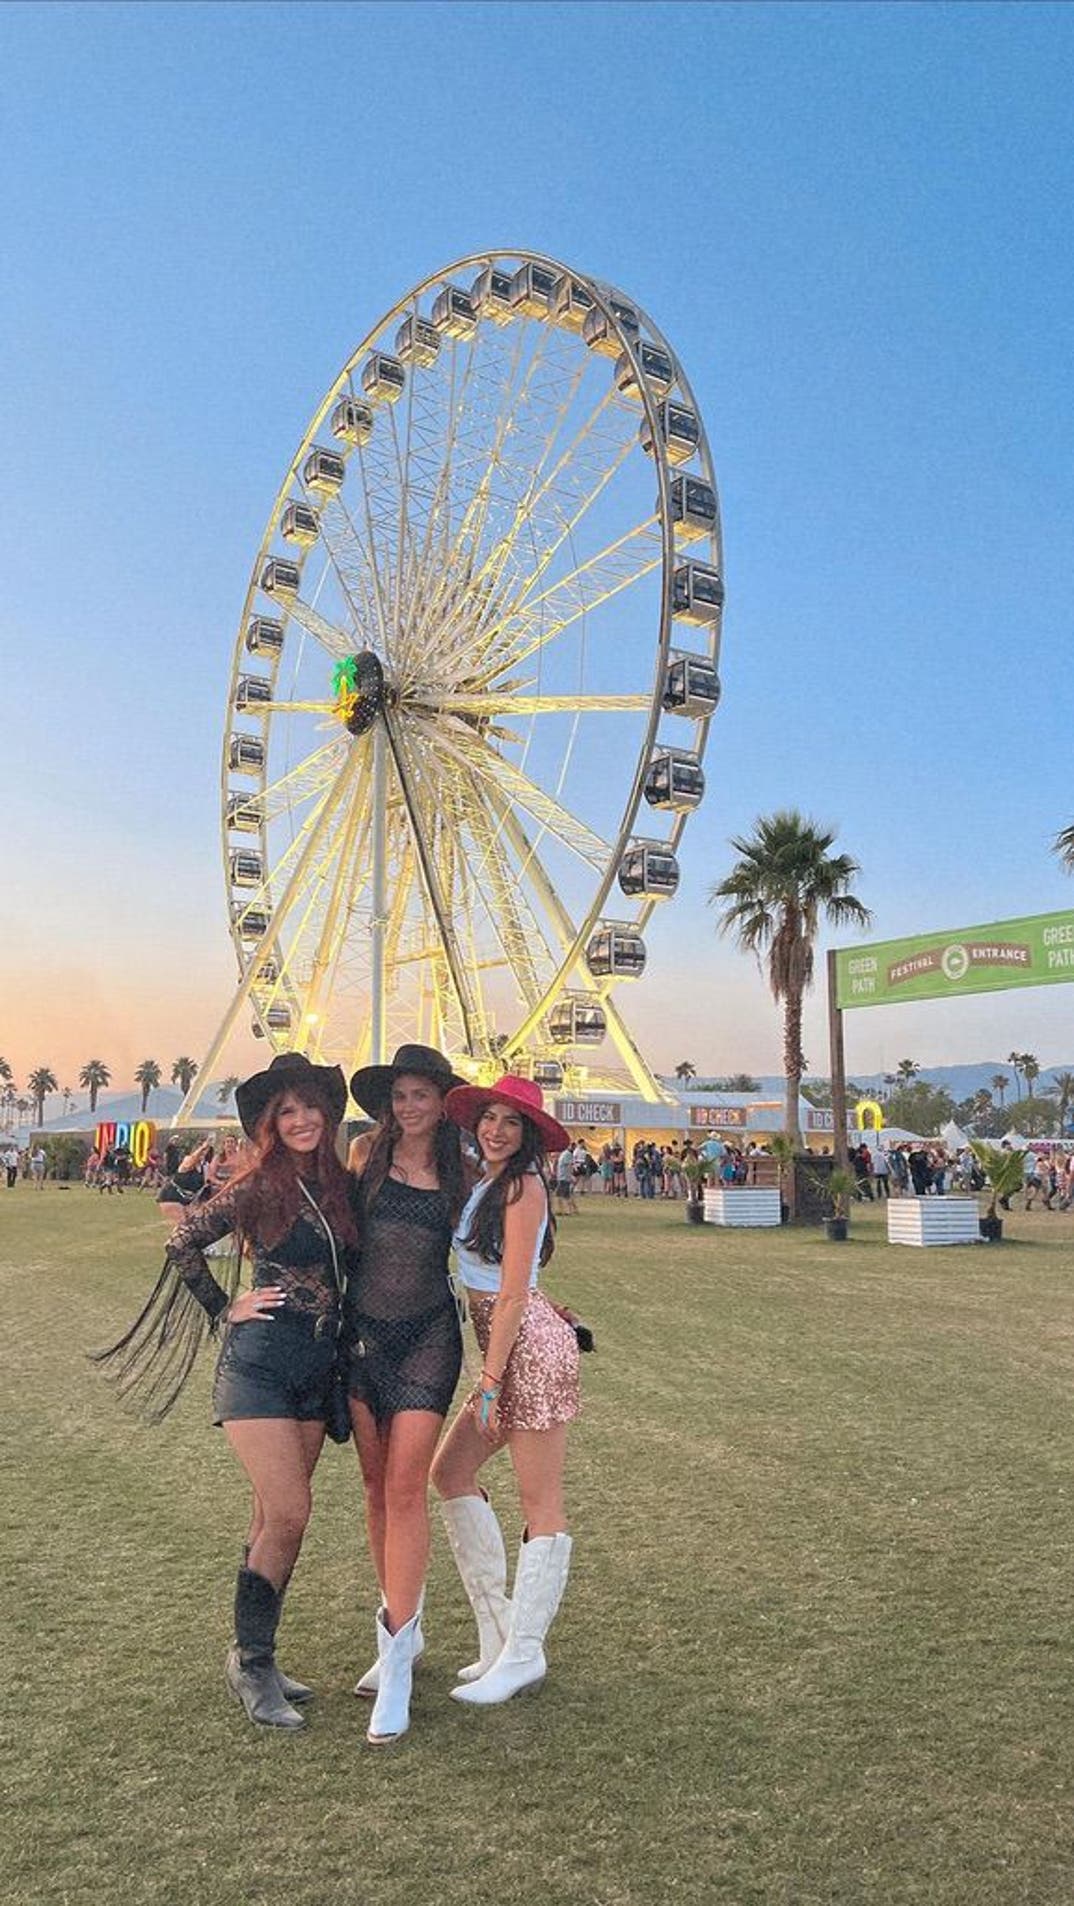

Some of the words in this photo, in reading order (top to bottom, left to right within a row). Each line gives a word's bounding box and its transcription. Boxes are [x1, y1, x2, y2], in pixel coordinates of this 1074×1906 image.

[848, 957, 878, 974] GREEN
[890, 955, 935, 980] FESTIVAL
[972, 948, 1027, 961] ENTRANCE
[852, 977, 875, 994] PATH
[562, 1103, 574, 1119] ID
[578, 1104, 614, 1120] CHECK
[709, 1109, 740, 1124] CHECK
